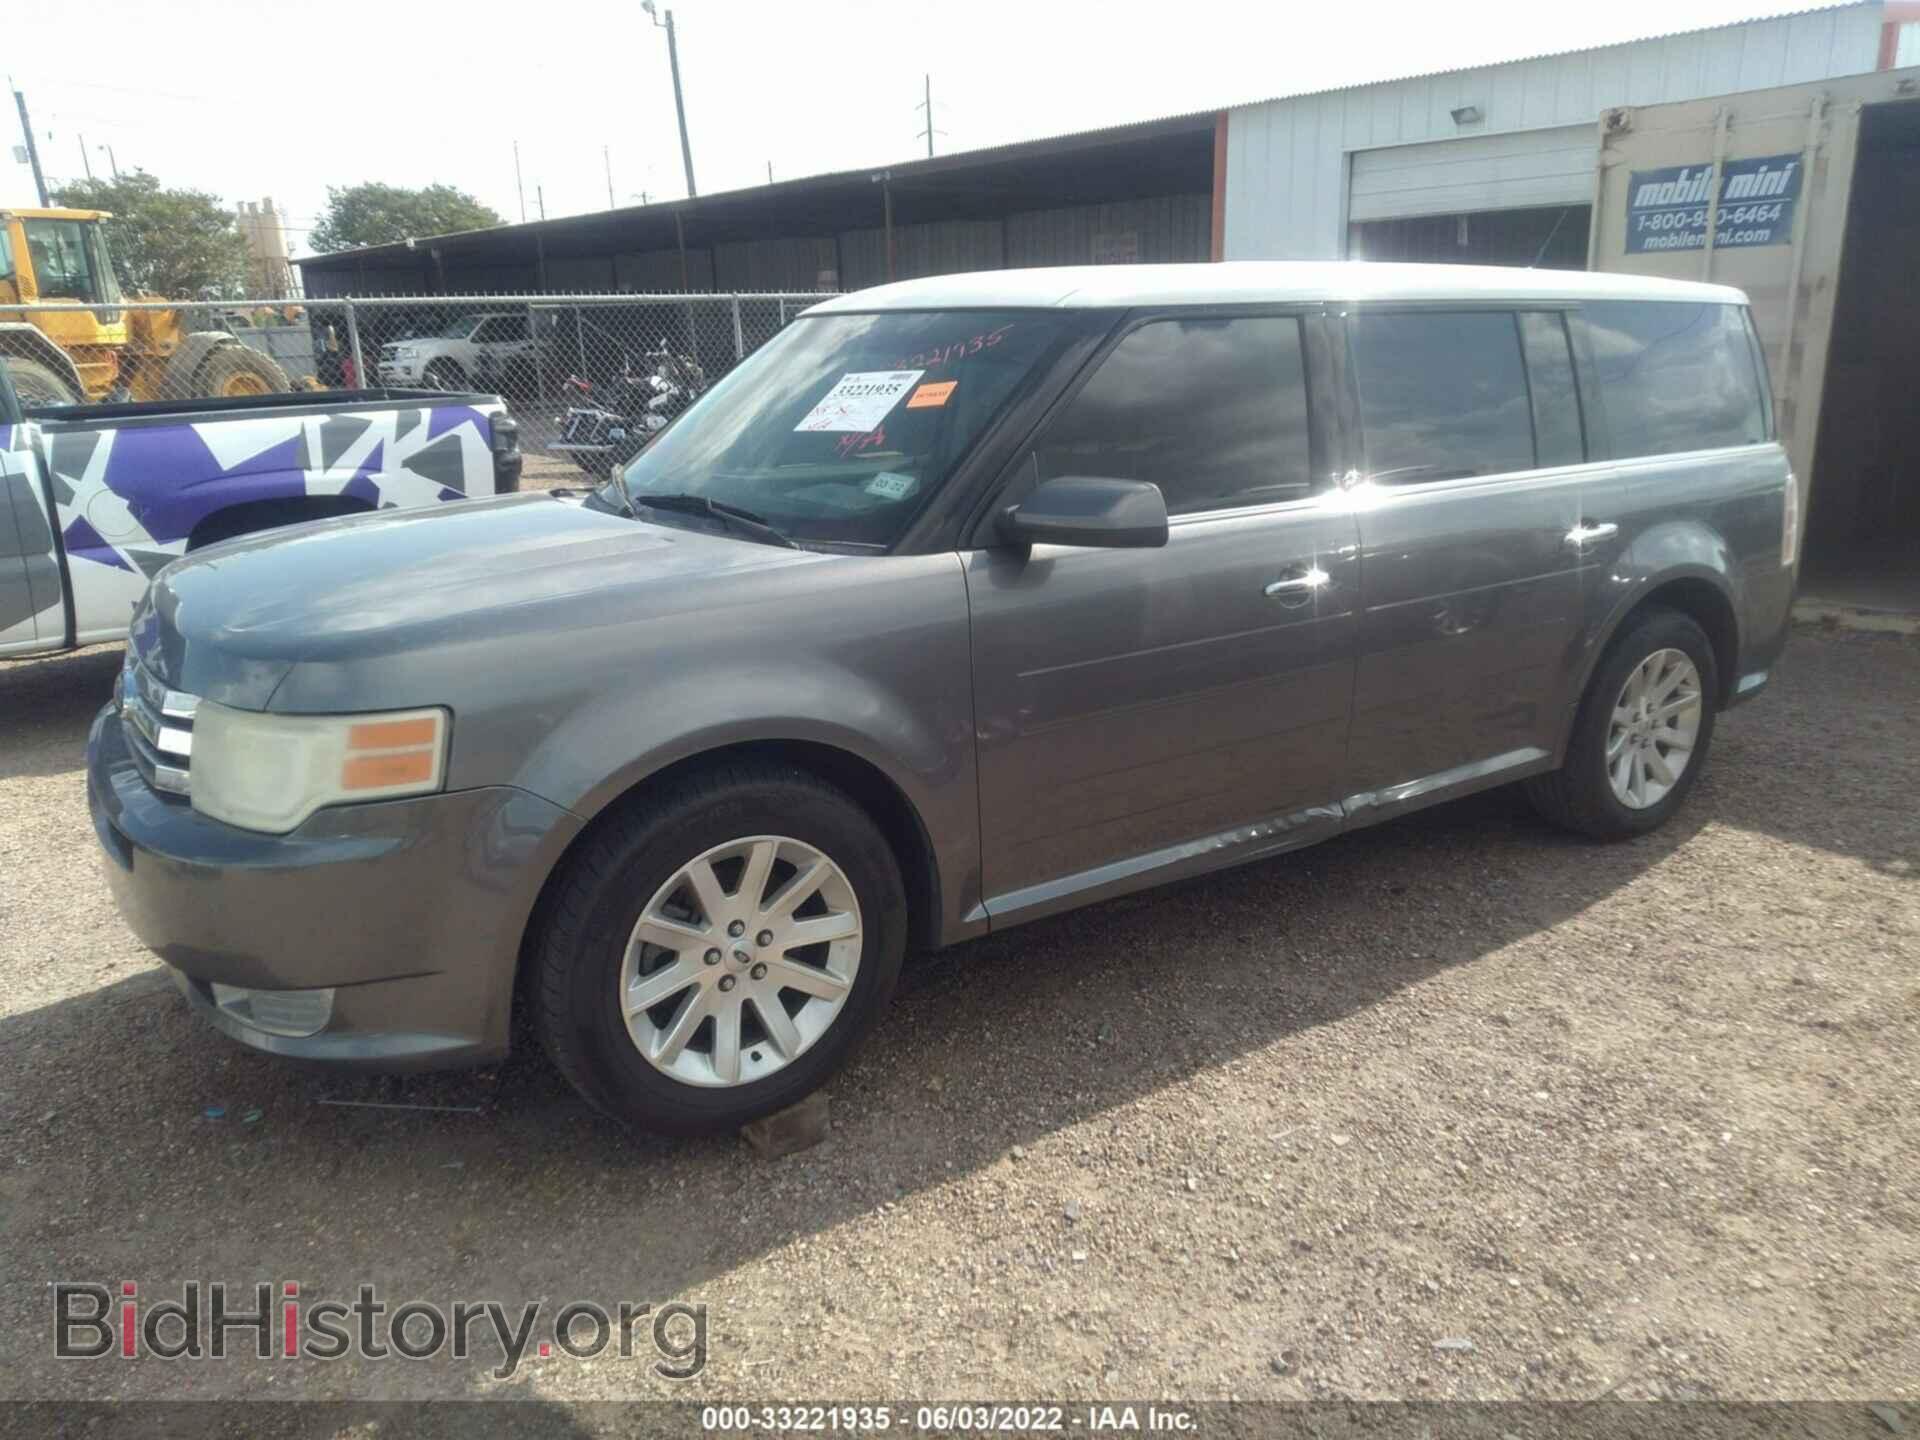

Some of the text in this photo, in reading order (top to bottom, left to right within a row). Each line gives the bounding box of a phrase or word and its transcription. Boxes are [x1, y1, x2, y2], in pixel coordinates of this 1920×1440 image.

[1724, 163, 1796, 199] mini
[1638, 204, 1783, 232] 1-800-90-6464
[1643, 228, 1772, 249] mobilemni.com
[833, 383, 902, 398] 33221935
